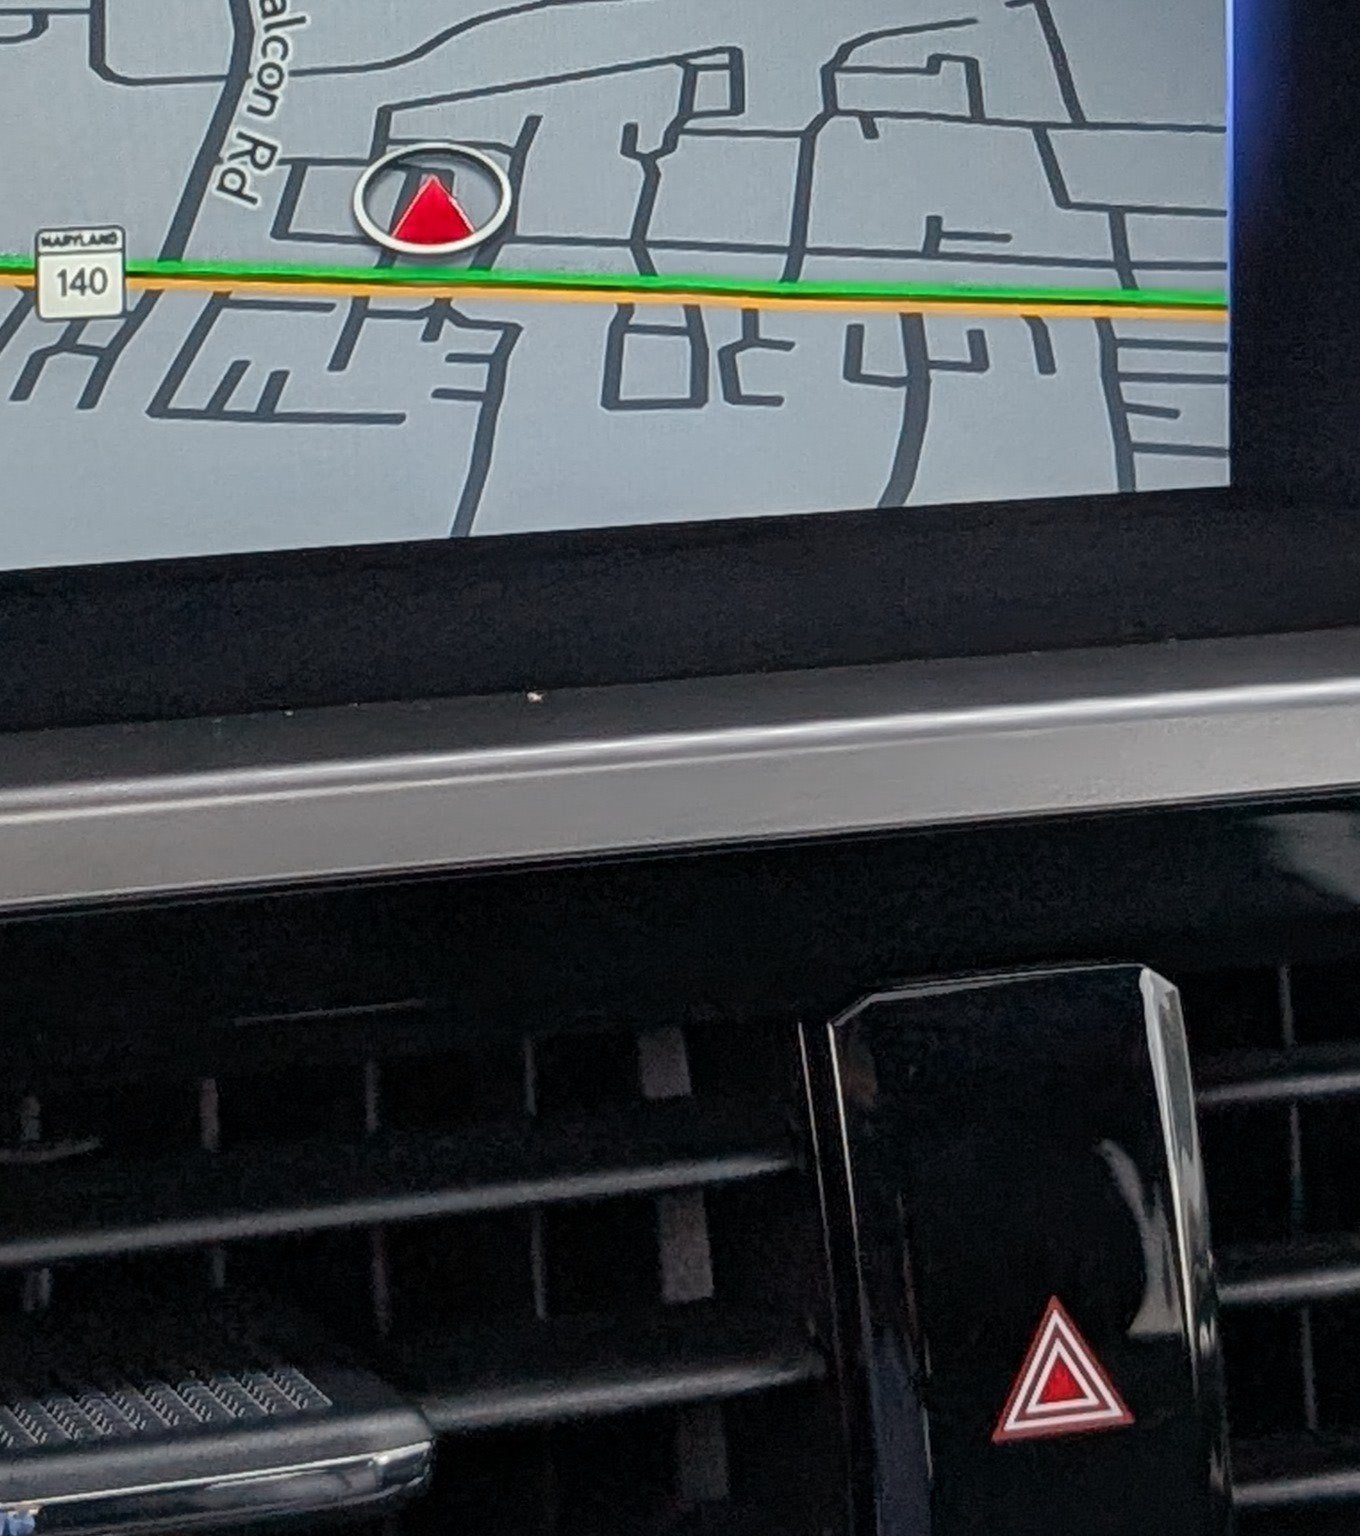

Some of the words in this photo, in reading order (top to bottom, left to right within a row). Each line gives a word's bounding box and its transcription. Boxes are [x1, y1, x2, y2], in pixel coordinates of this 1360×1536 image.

[215, 131, 278, 206] Rd
[40, 231, 119, 247] MARYLAND
[56, 266, 109, 297] 140
